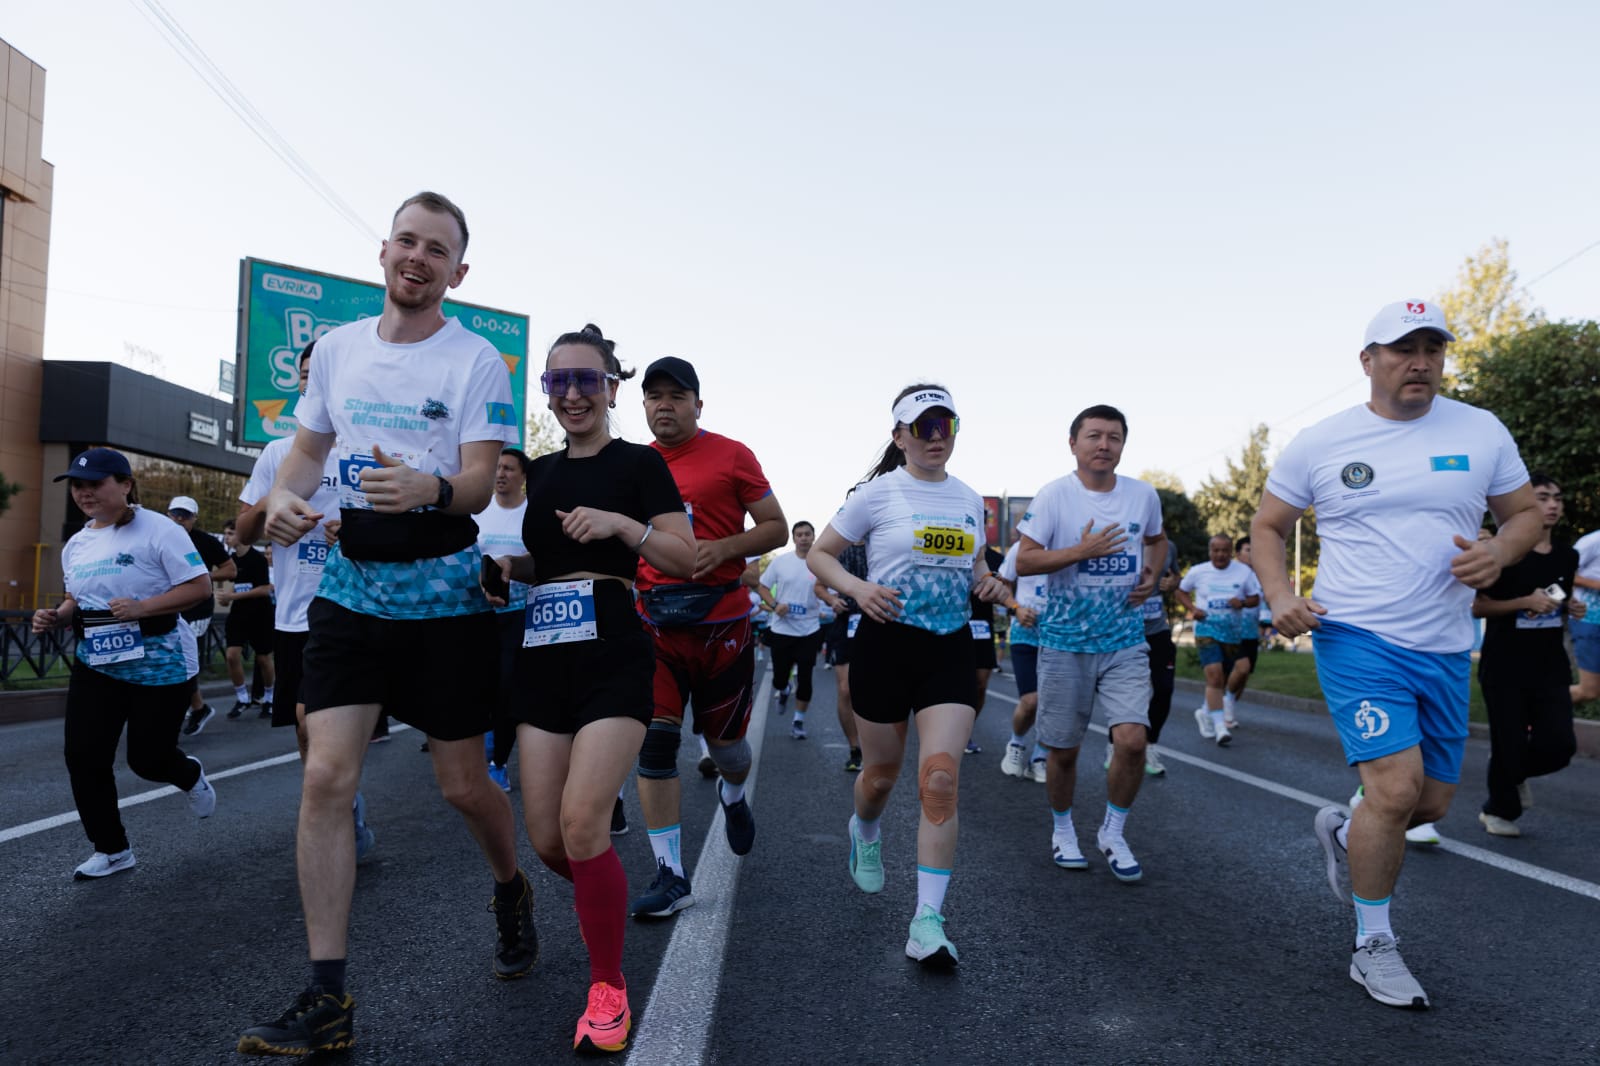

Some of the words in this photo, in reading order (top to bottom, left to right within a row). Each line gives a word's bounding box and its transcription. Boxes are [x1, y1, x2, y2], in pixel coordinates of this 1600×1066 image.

[267, 277, 318, 297] EVRIKA
[351, 411, 429, 432] Marathon
[923, 532, 965, 552] 8091
[1087, 556, 1130, 572] 5599
[532, 599, 583, 625] 6690
[92, 634, 135, 652] 6409
